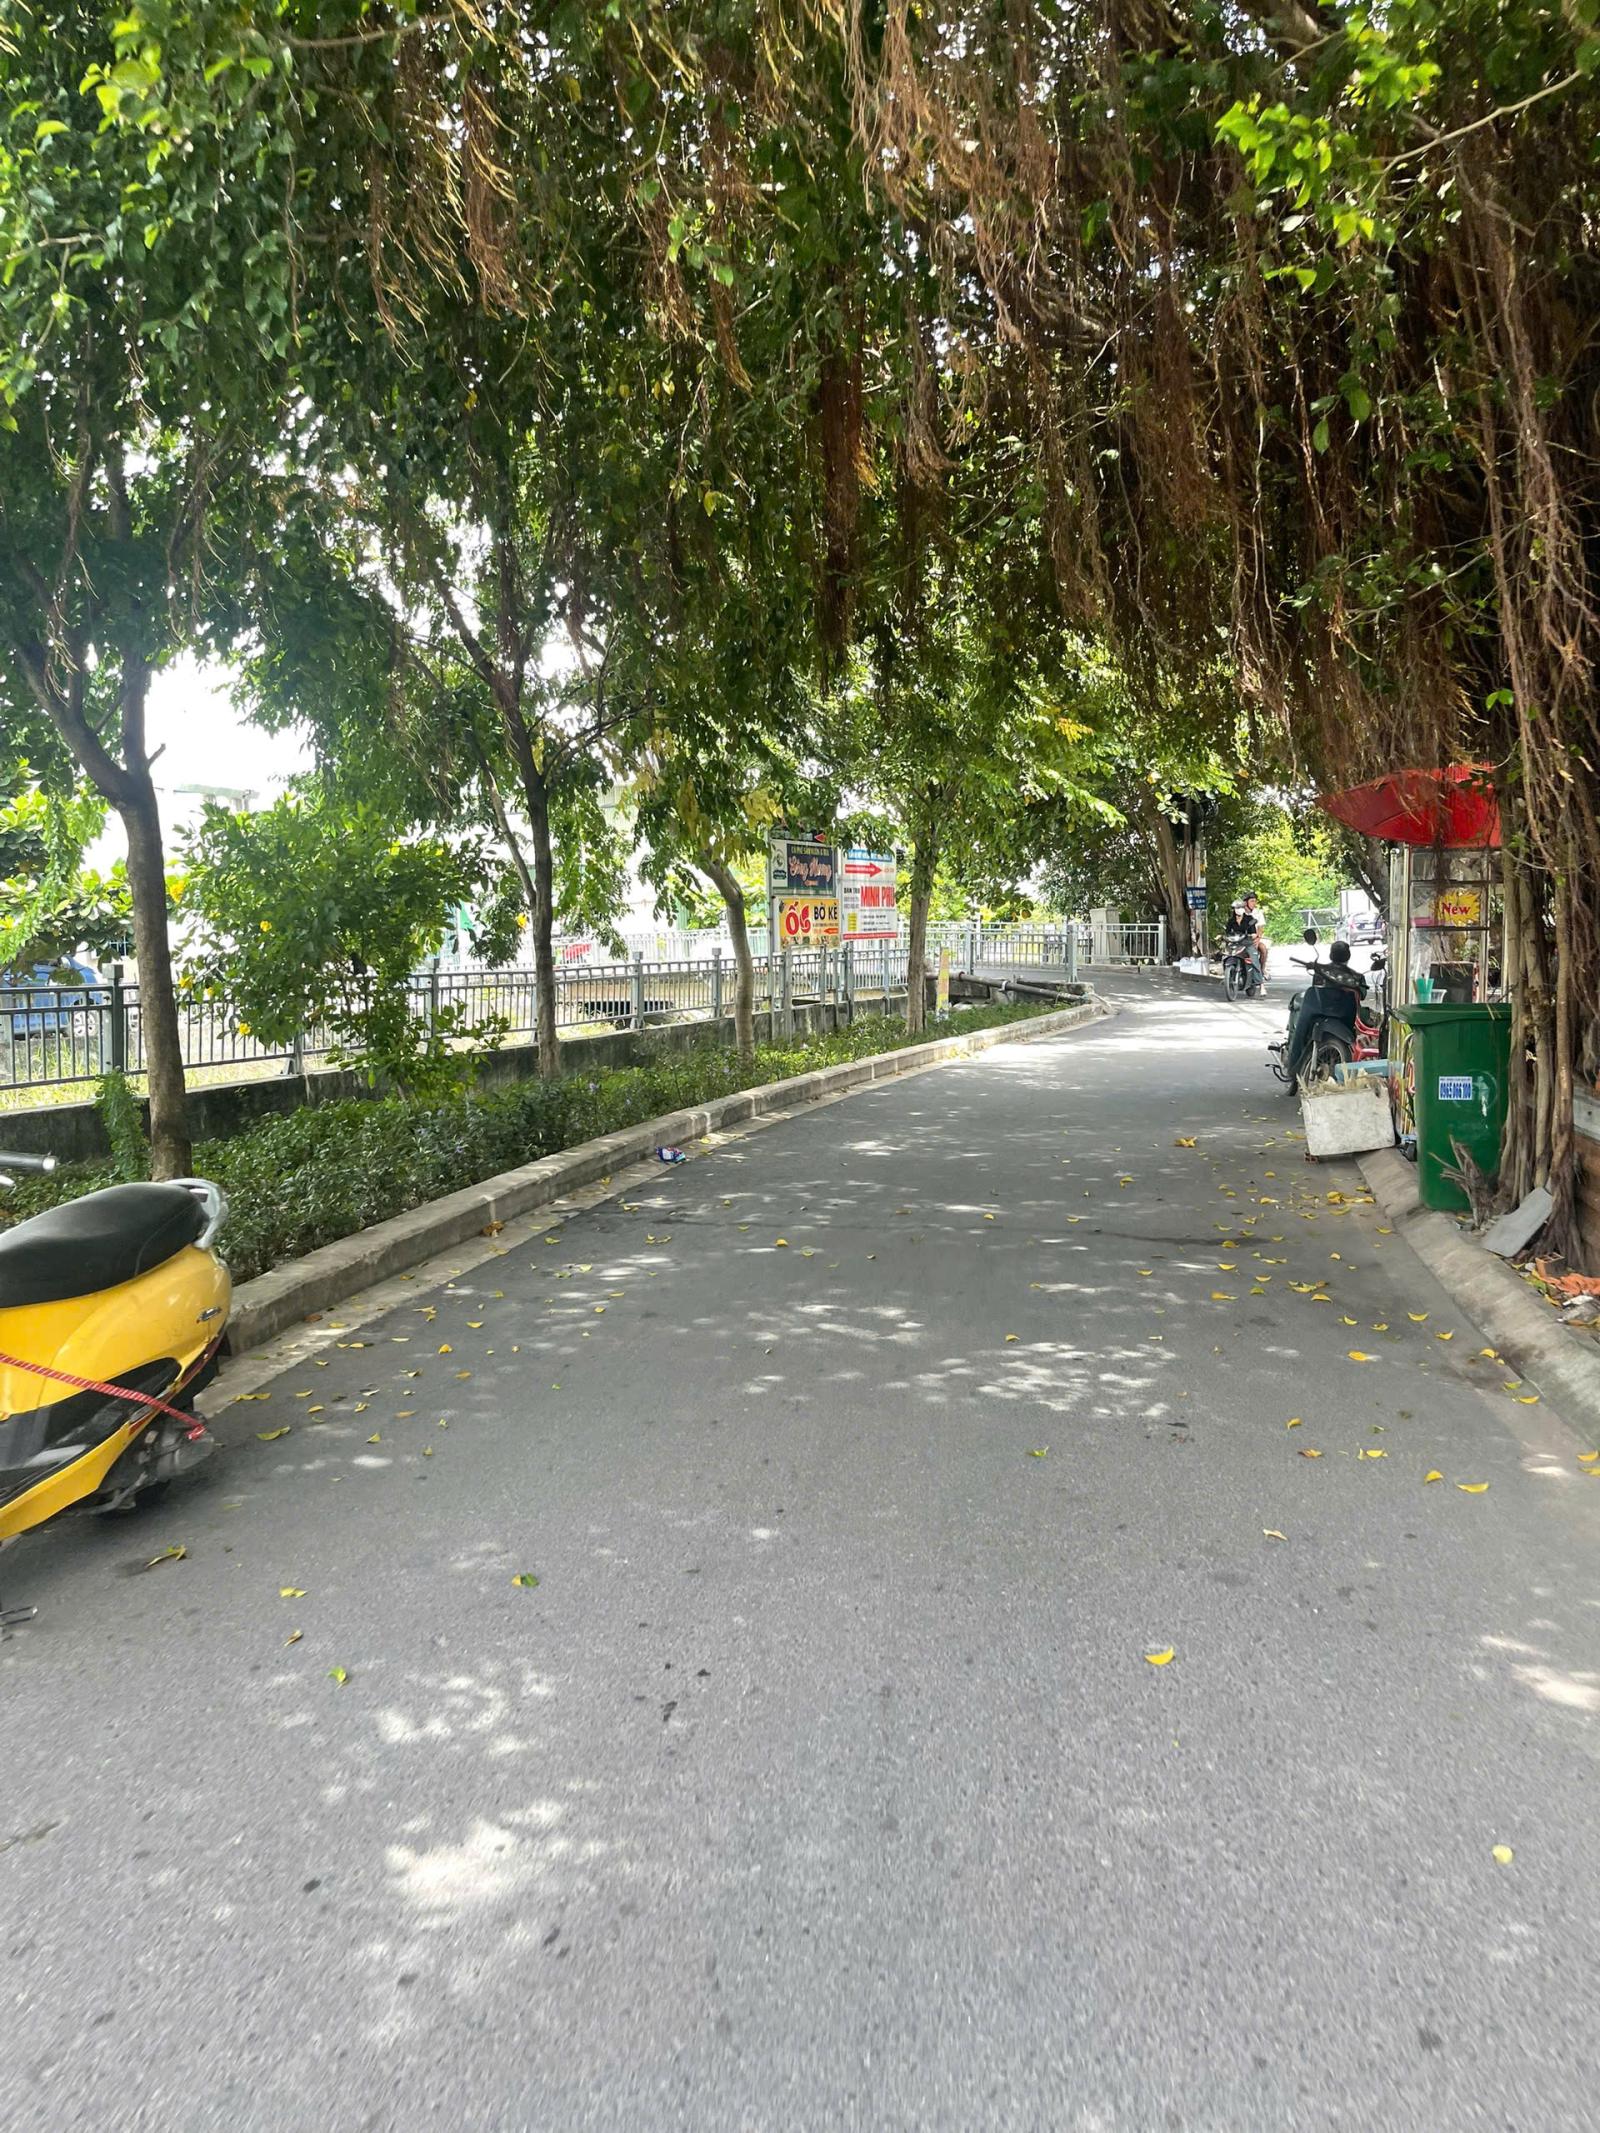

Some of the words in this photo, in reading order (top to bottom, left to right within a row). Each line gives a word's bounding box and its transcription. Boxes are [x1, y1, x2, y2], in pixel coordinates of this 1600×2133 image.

[861, 886, 880, 907] MINH
[814, 902, 826, 920] BÒ
[1442, 902, 1472, 915] New
